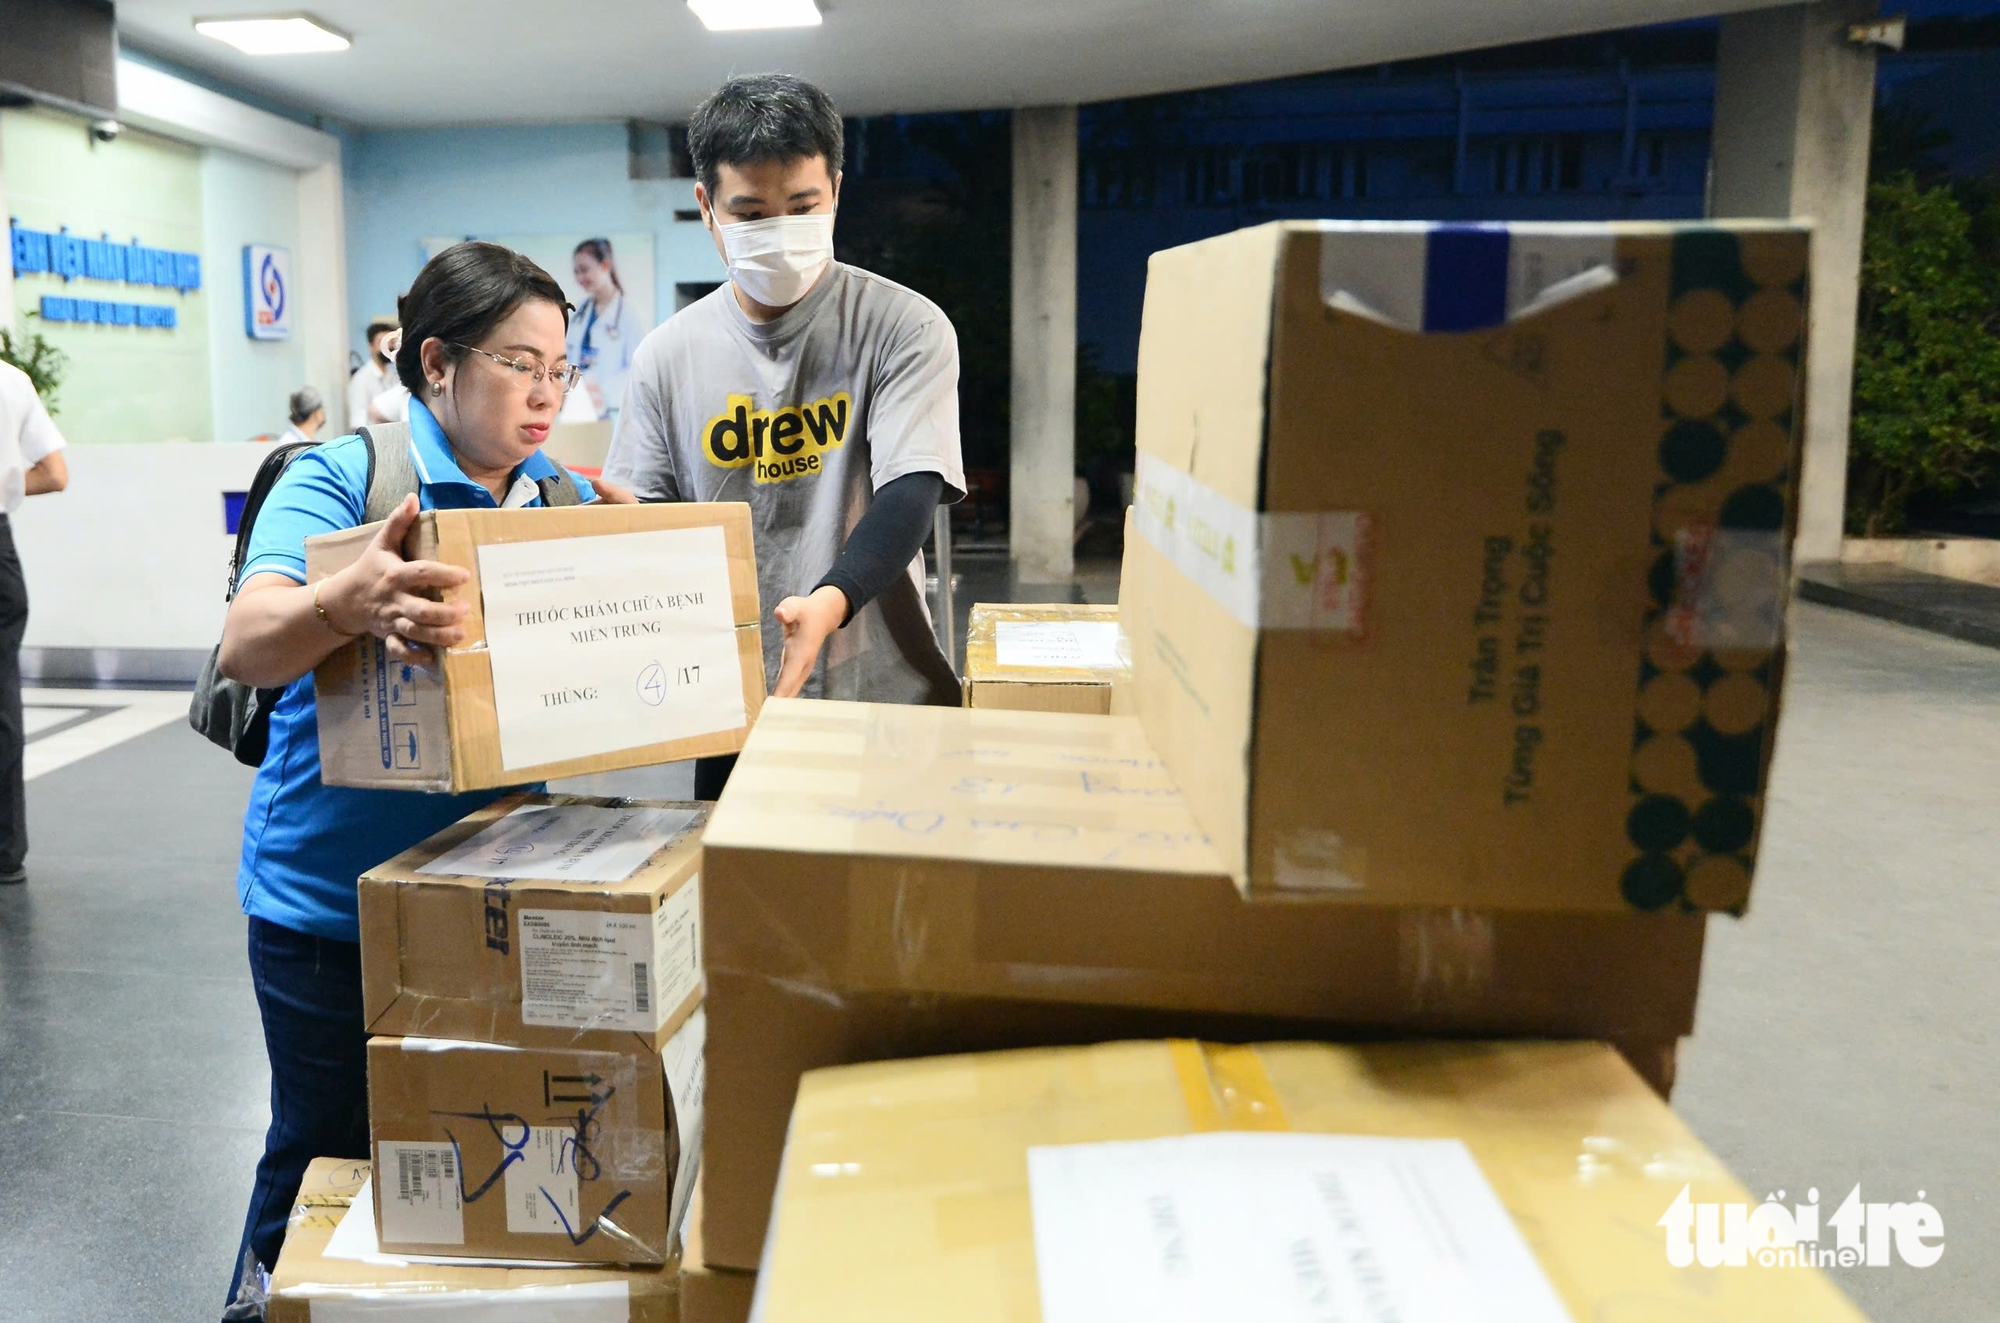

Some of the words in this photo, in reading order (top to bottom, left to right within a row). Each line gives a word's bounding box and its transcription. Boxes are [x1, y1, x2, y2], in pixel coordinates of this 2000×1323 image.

[710, 399, 847, 462] drew
[758, 454, 819, 479] house
[515, 606, 570, 627] THUỐC
[573, 599, 619, 620] KHÁM
[622, 595, 665, 615] CHỮA
[667, 591, 705, 611] BỆNH
[570, 625, 609, 645] MIỀN
[610, 620, 662, 640] TRUNG
[540, 686, 599, 708] THÙNG:
